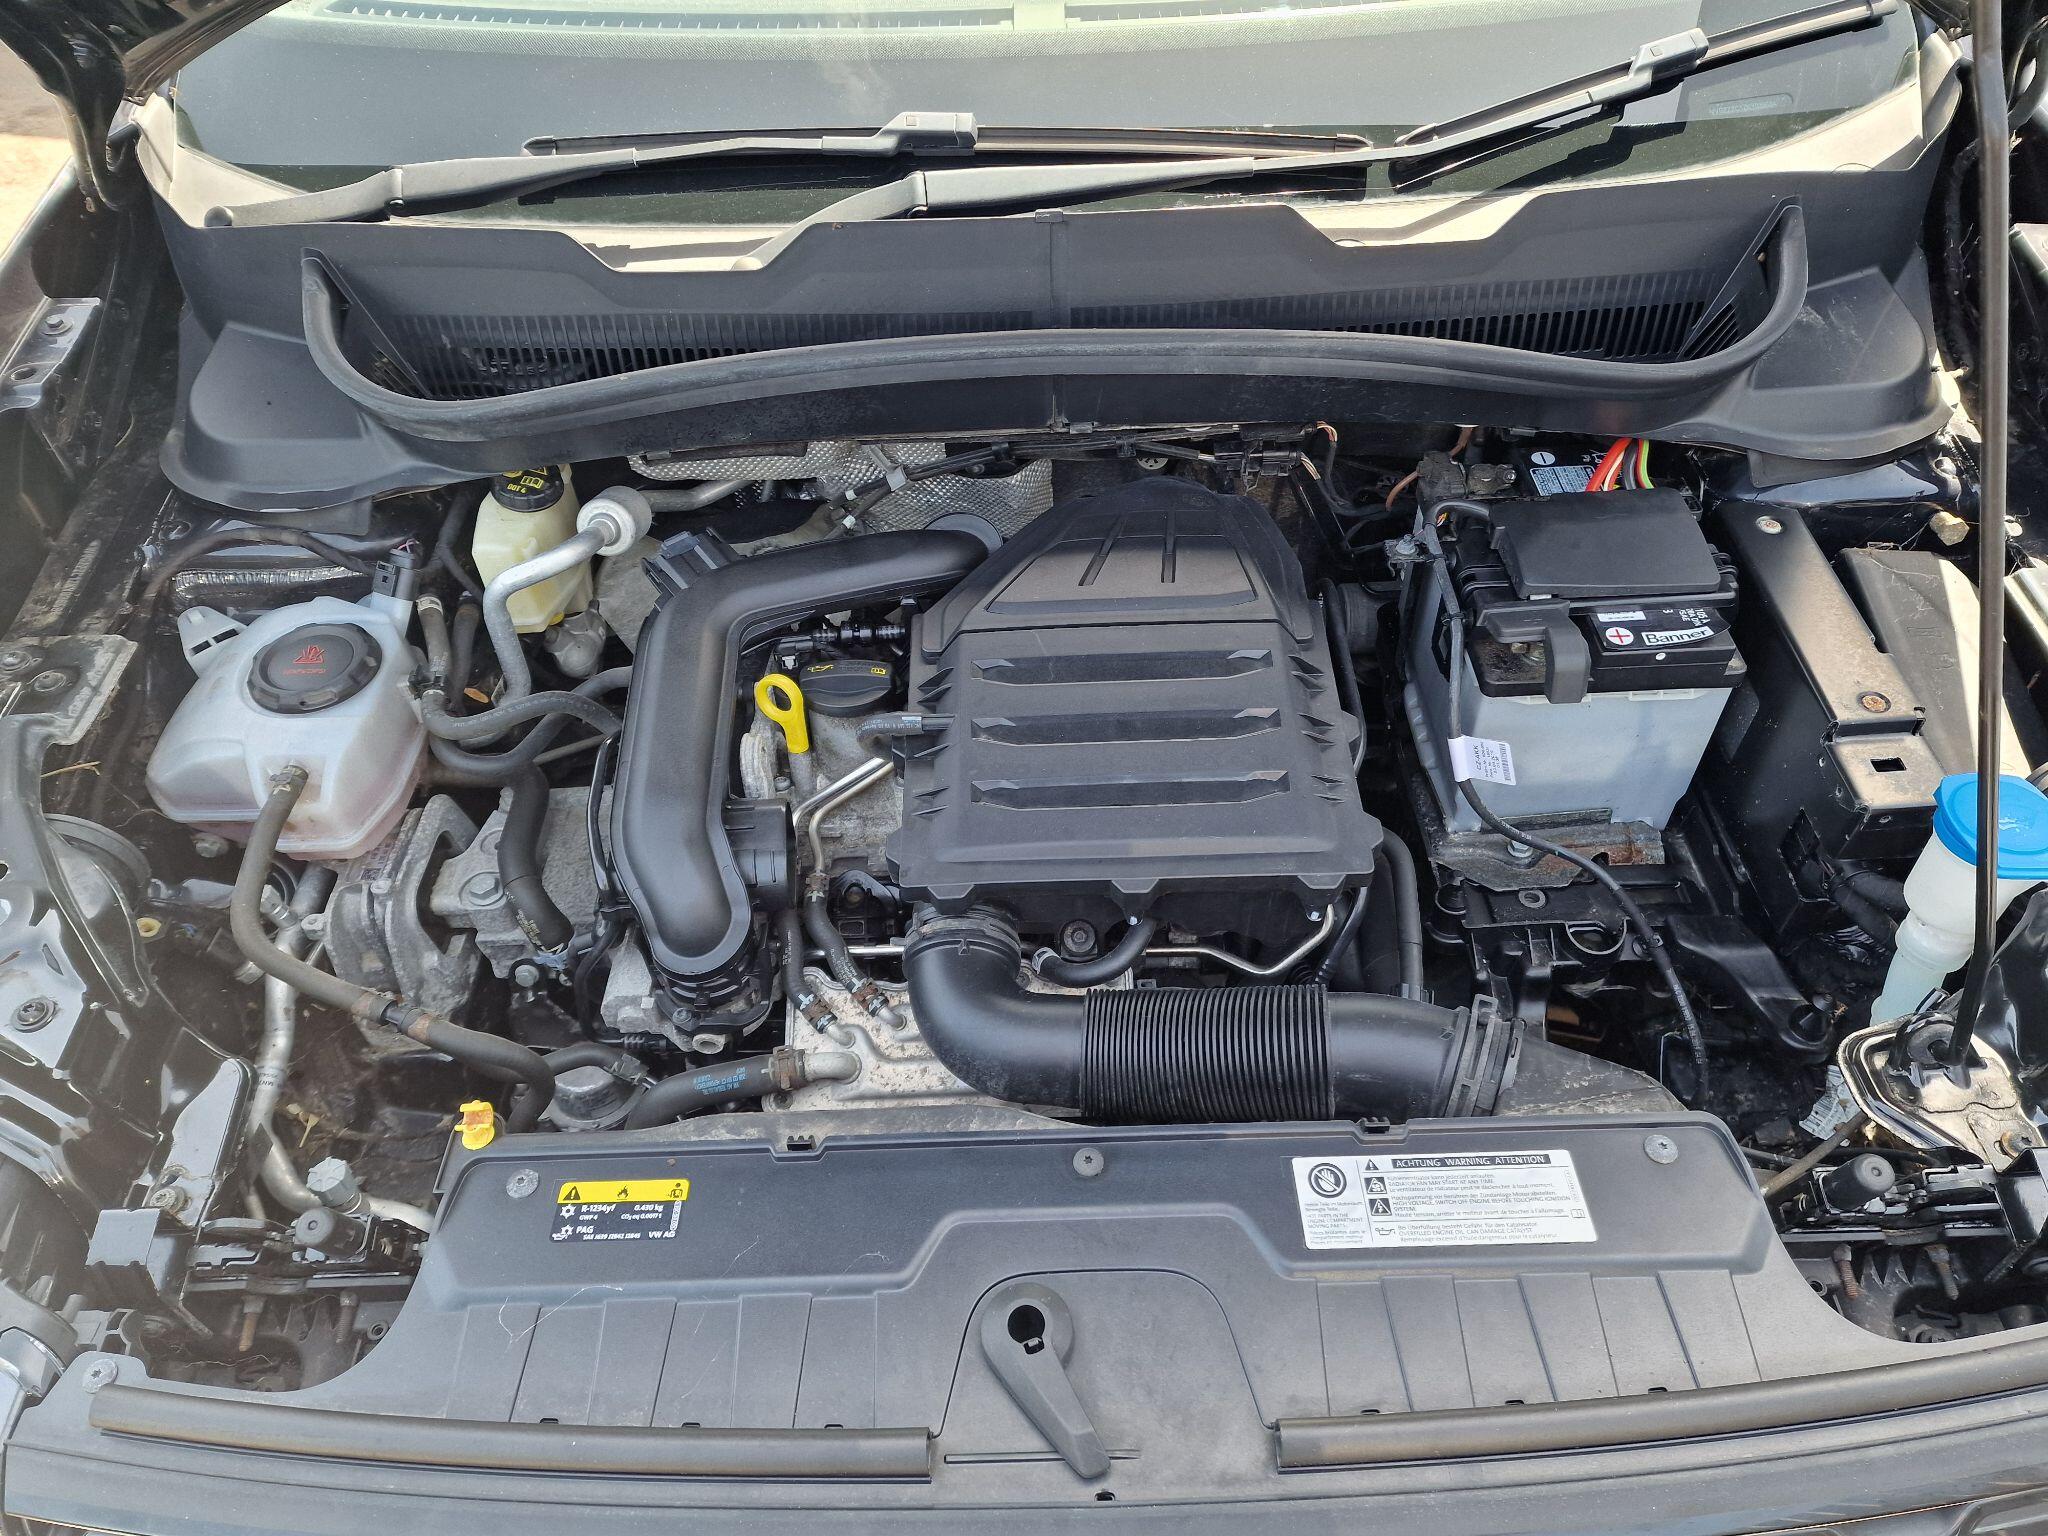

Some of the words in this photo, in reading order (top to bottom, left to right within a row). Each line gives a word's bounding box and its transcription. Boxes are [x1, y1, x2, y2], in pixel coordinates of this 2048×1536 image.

[507, 484, 521, 492] DOT
[1645, 629, 1708, 644] Banner
[1396, 1159, 1440, 1167] ACHTUNG
[1445, 1158, 1490, 1166] WARNING
[1496, 1156, 1544, 1164] ATTENTION
[580, 1204, 616, 1214] R-1234yf
[654, 1204, 664, 1212] kg
